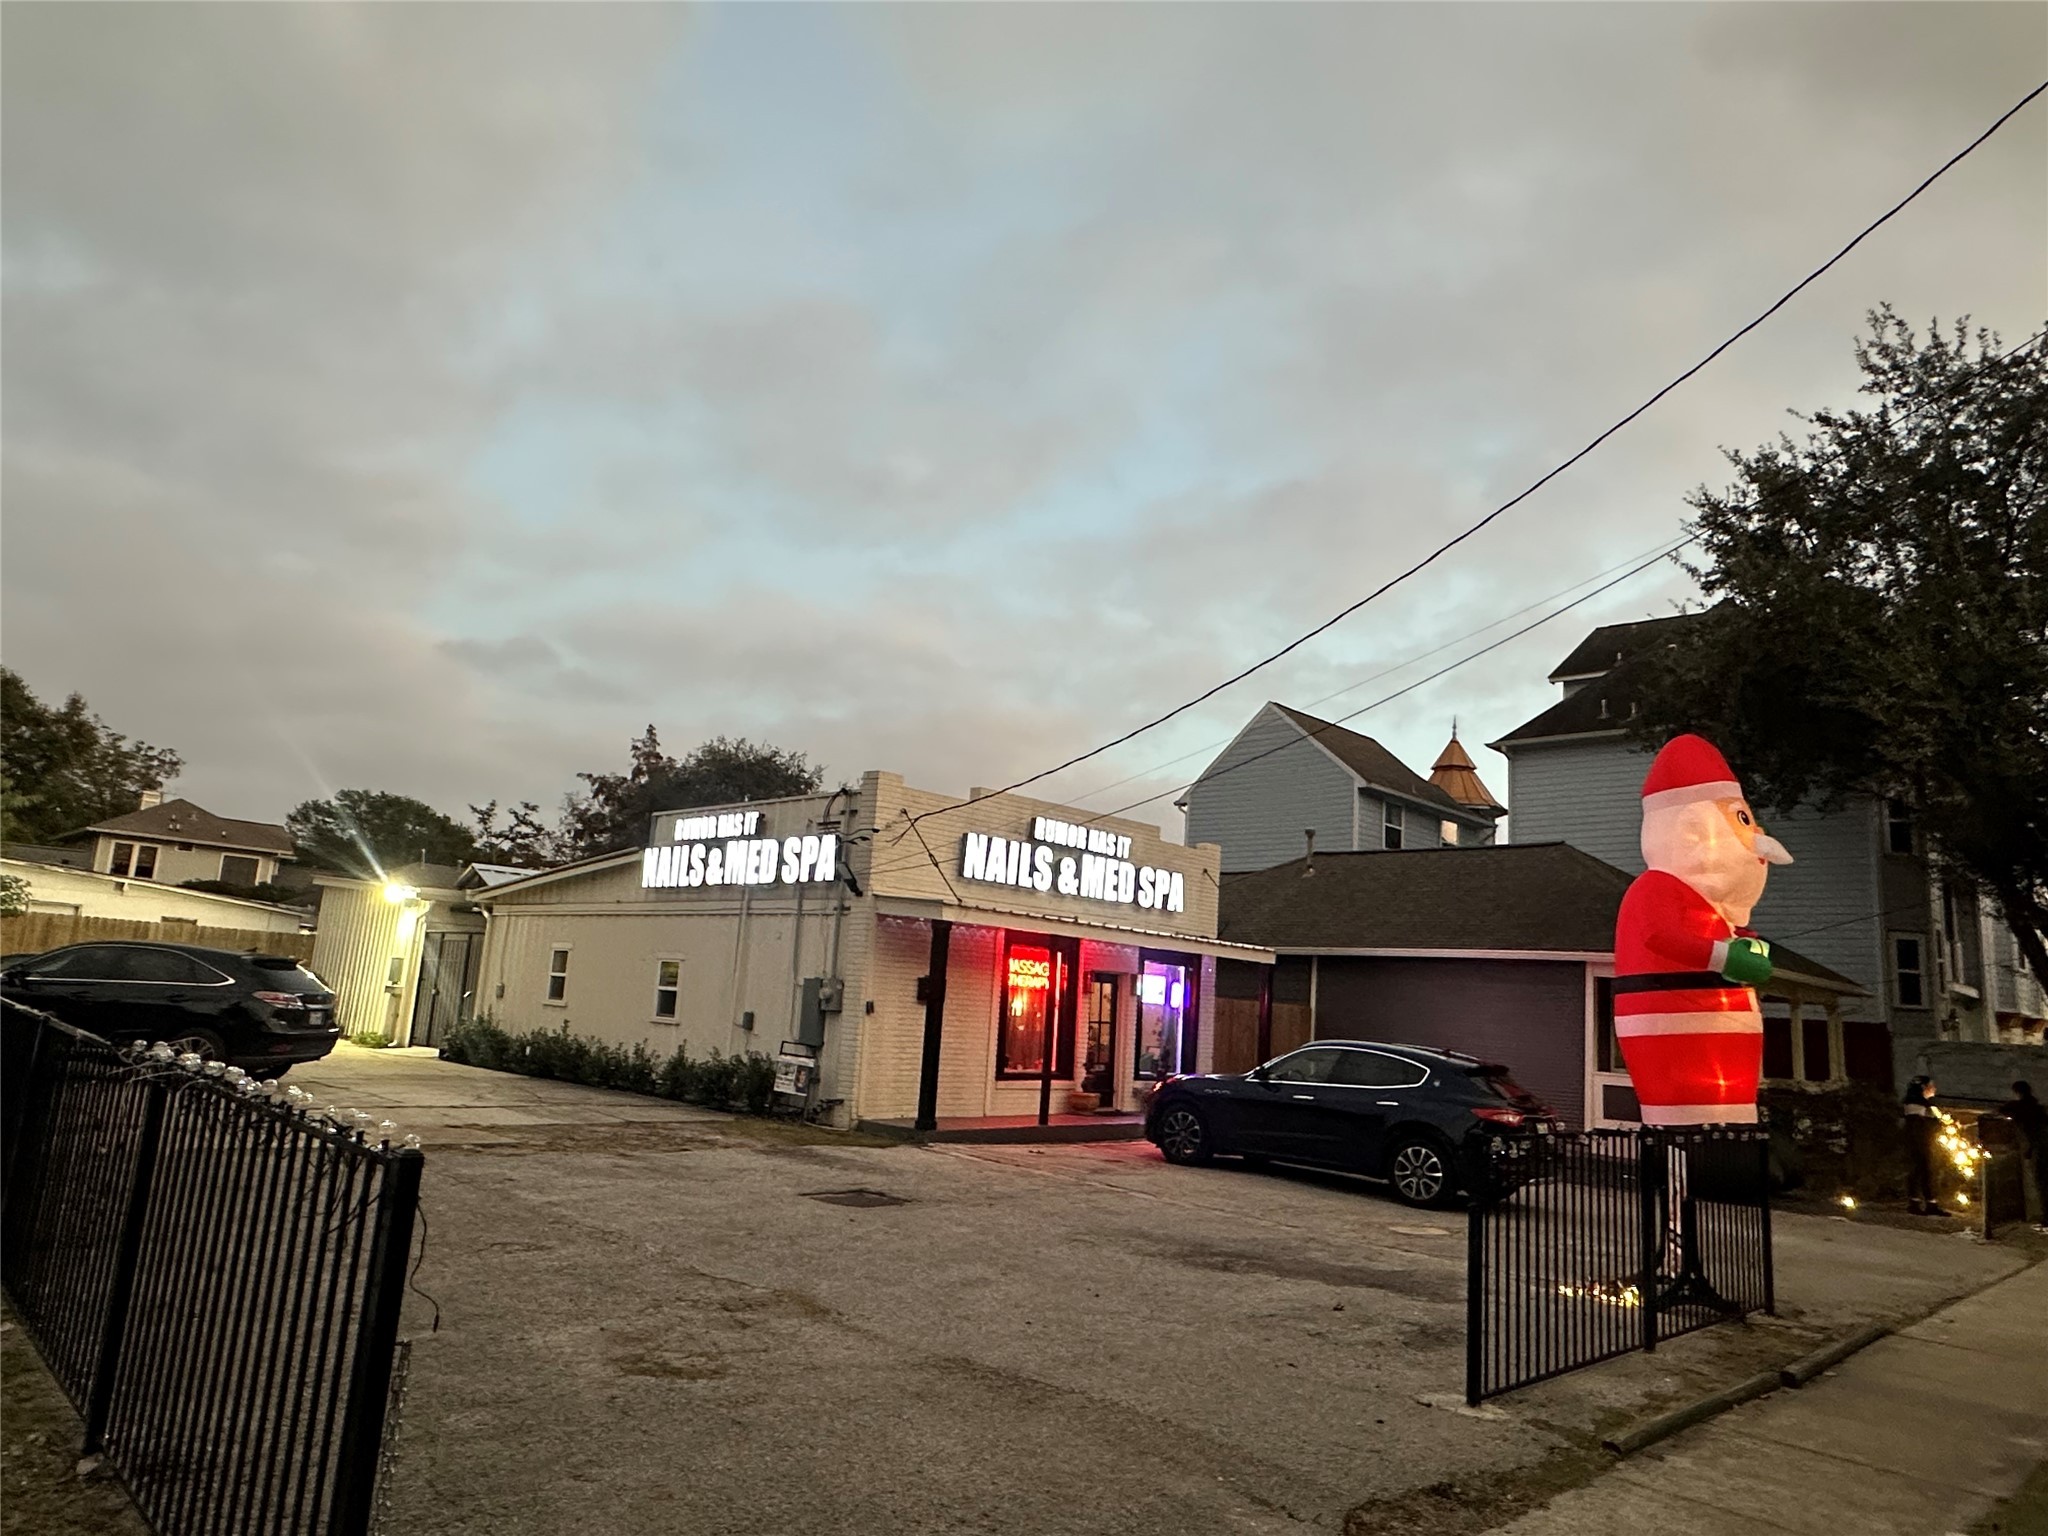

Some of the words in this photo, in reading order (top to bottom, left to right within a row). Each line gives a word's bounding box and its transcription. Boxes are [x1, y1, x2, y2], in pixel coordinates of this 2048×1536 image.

[743, 811, 760, 836] IT
[1033, 816, 1087, 850] RUMOR
[1087, 829, 1117, 857] HAS
[1116, 835, 1132, 859] IT
[642, 843, 707, 888] NAILS
[705, 847, 724, 886] &
[724, 838, 779, 886] MED
[781, 834, 836, 885] SPA
[963, 832, 1054, 892] NAILS
[1057, 856, 1080, 896] &
[1080, 853, 1136, 904] MED
[1137, 865, 1185, 913] SPA
[1009, 958, 1050, 977] ASSAG
